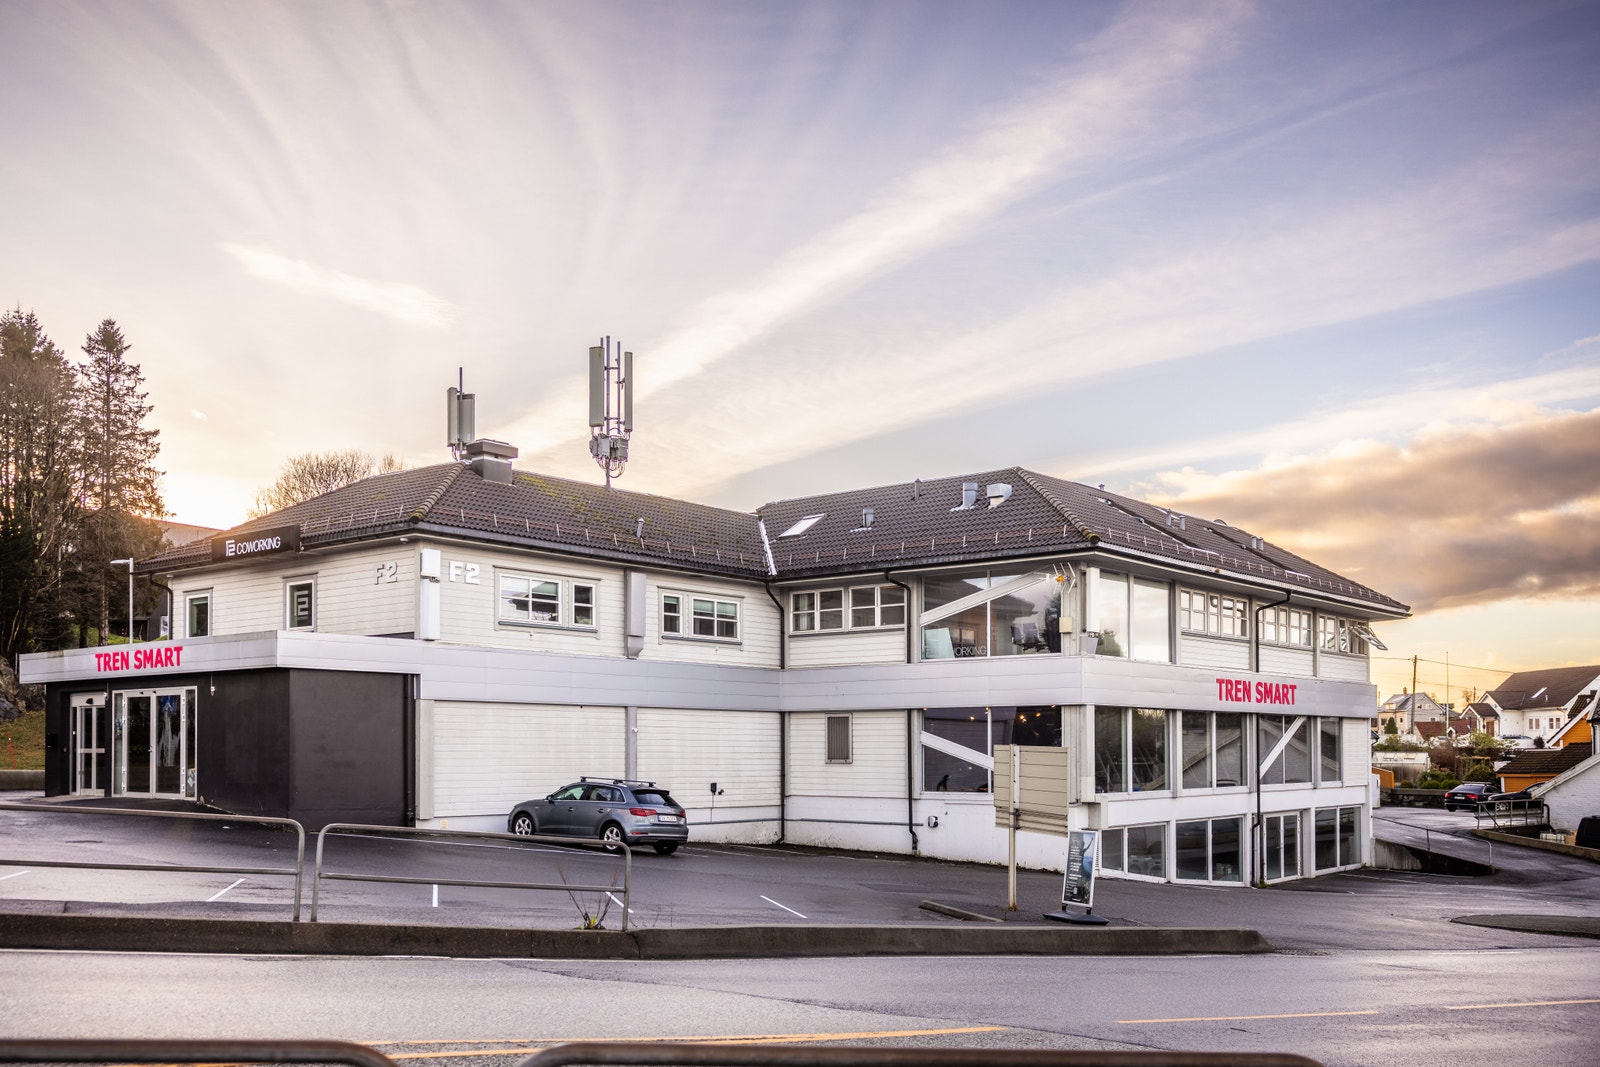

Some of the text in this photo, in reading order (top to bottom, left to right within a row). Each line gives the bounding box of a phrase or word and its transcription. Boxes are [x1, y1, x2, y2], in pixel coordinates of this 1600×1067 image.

[236, 536, 281, 555] COWORKING
[374, 561, 398, 586] F2
[448, 560, 480, 585] F2
[95, 646, 183, 672] TREN SMART
[1216, 678, 1297, 705] TREN SMART
